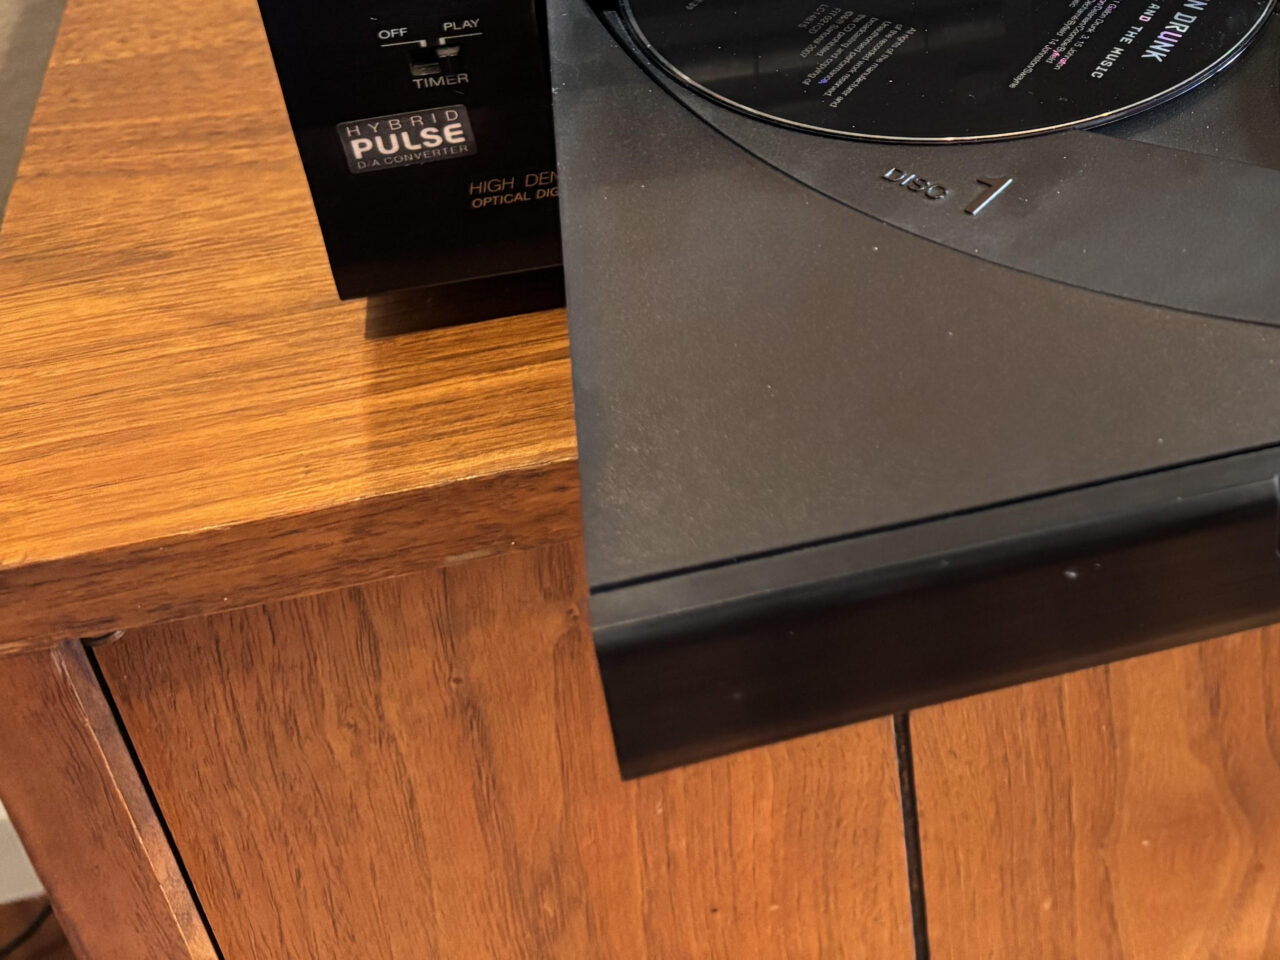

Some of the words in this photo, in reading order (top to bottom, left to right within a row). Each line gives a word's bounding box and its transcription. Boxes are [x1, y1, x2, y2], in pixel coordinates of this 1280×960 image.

[1139, 2, 1161, 23] AND
[378, 27, 407, 40] OFF
[443, 19, 480, 32] PLAY
[1119, 26, 1143, 45] THE
[1141, 11, 1197, 63] DRUNK
[806, 57, 833, 79] copying
[1091, 46, 1125, 79] MUSIC
[413, 73, 469, 90] TIMER
[840, 61, 880, 96] manufacturer
[828, 94, 844, 108] and
[346, 110, 459, 137] HYBRID
[351, 123, 466, 159] PULSE
[384, 145, 469, 165] CONVERTER
[469, 176, 515, 195] HIGH
[881, 167, 949, 200] DISC
[964, 175, 1014, 216] 1
[472, 191, 531, 208] OPTICAL
